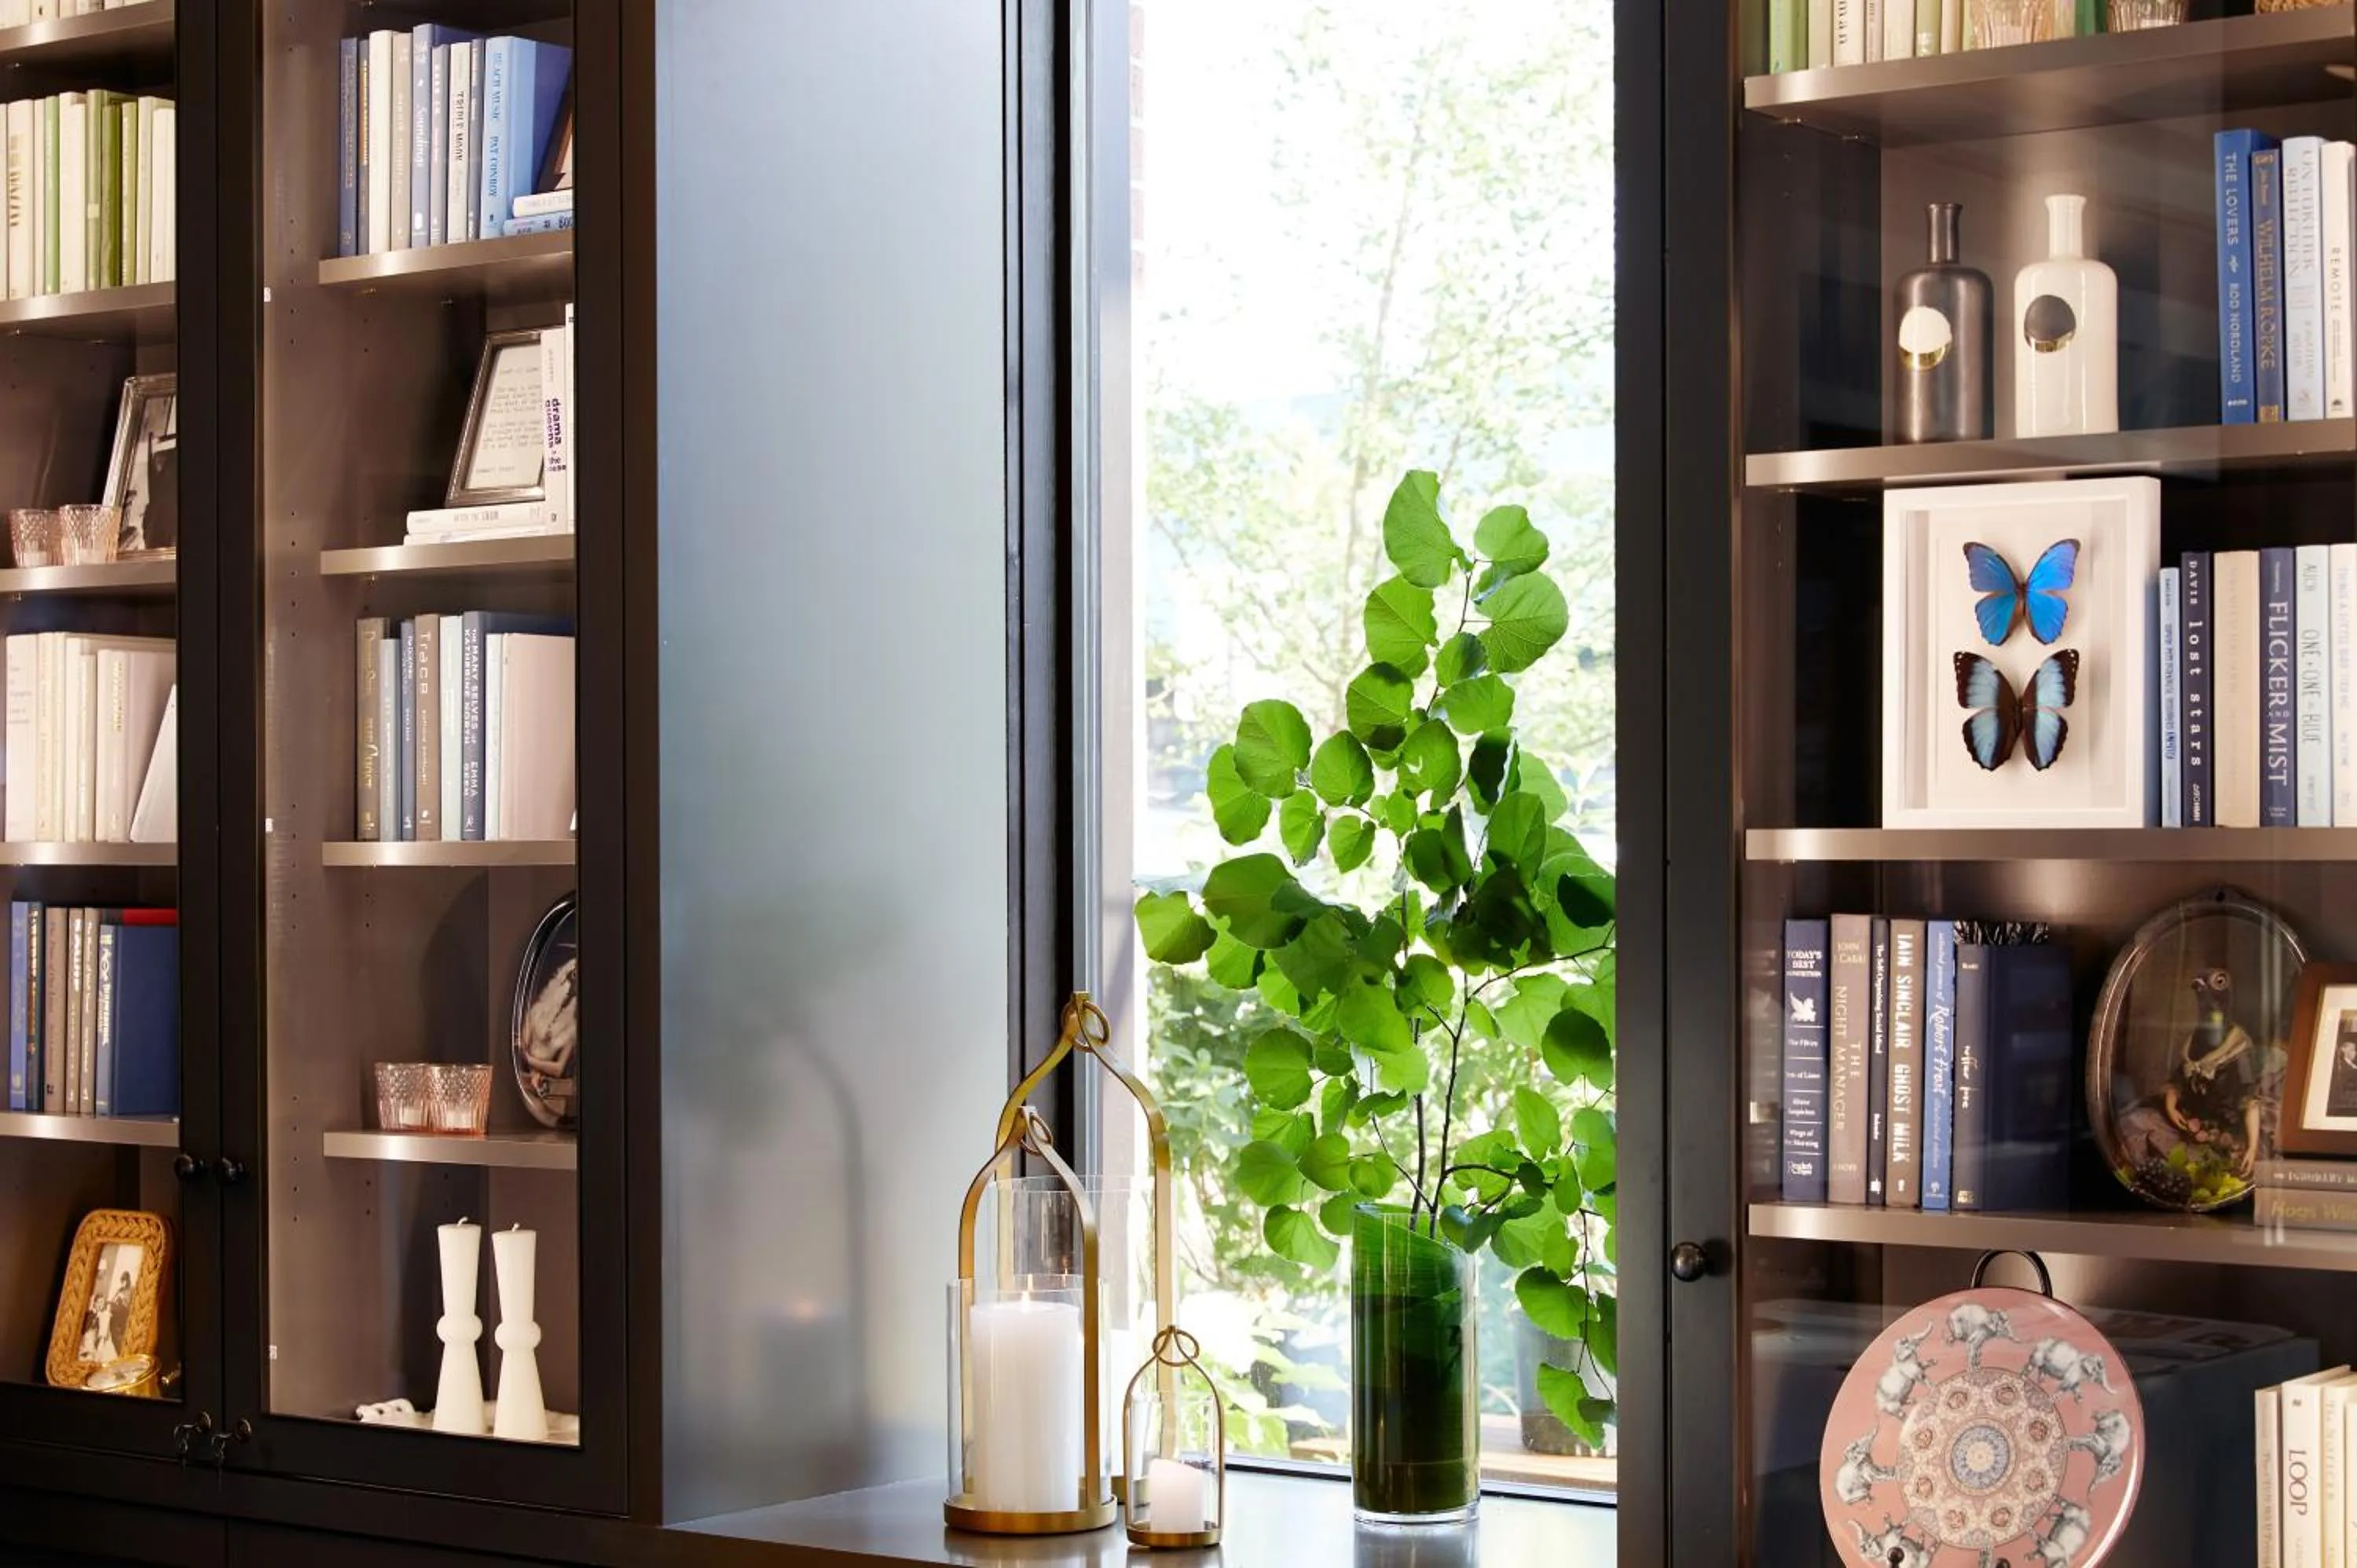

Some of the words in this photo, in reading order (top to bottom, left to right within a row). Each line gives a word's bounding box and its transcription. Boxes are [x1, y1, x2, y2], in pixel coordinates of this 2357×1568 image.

[489, 136, 499, 153] PAT
[2225, 152, 2238, 182] THE
[2226, 189, 2238, 246] LOVERS
[2258, 219, 2275, 302] WILHELM
[2330, 247, 2341, 311] REMOTE
[2229, 283, 2241, 309] ROD
[2230, 313, 2242, 383] NORDLAND
[552, 398, 563, 445] drama
[2189, 560, 2198, 605] DAVIS
[2189, 621, 2203, 676] lost
[2268, 602, 2289, 709] FLICKER
[2301, 629, 2321, 658] ONE
[2301, 670, 2322, 698] ONE
[2190, 694, 2203, 767] stars
[2267, 723, 2288, 786] MIST
[2301, 714, 2322, 745] BLUE
[1792, 960, 1816, 969] BEST
[1897, 934, 1913, 967] IAIN
[1835, 986, 1849, 1039] NIGHT
[1895, 975, 1913, 1049] SINCLAIR
[1930, 1004, 1950, 1056] Robert
[1849, 1039, 1861, 1078] THE
[1932, 1057, 1949, 1099] Frost
[1833, 1046, 1848, 1131] MANAGER
[1893, 1064, 1912, 1114] GHOST
[1893, 1123, 1911, 1163] MILK
[2289, 1449, 2308, 1515] LOOP
